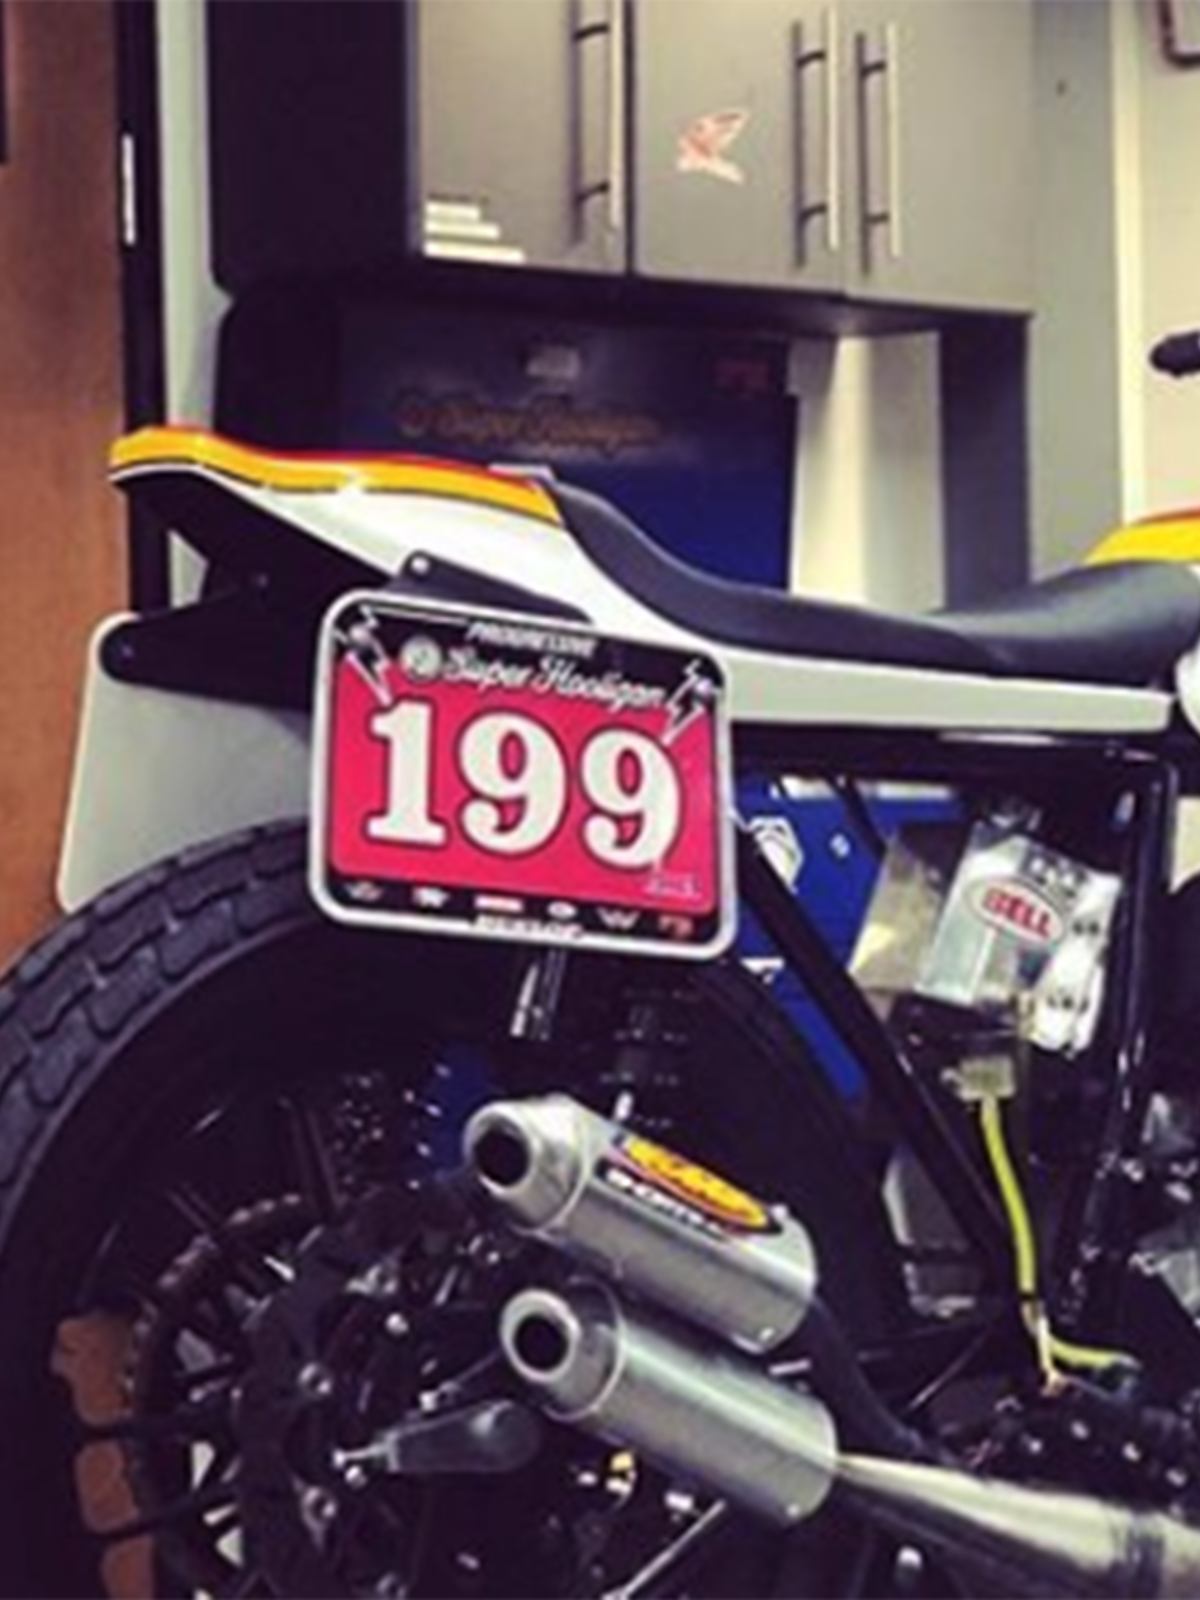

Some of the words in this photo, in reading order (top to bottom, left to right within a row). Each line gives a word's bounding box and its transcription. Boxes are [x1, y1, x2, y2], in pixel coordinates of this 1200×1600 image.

[444, 646, 532, 692] Super
[367, 700, 682, 869] 199
[983, 887, 1050, 938] BELL
